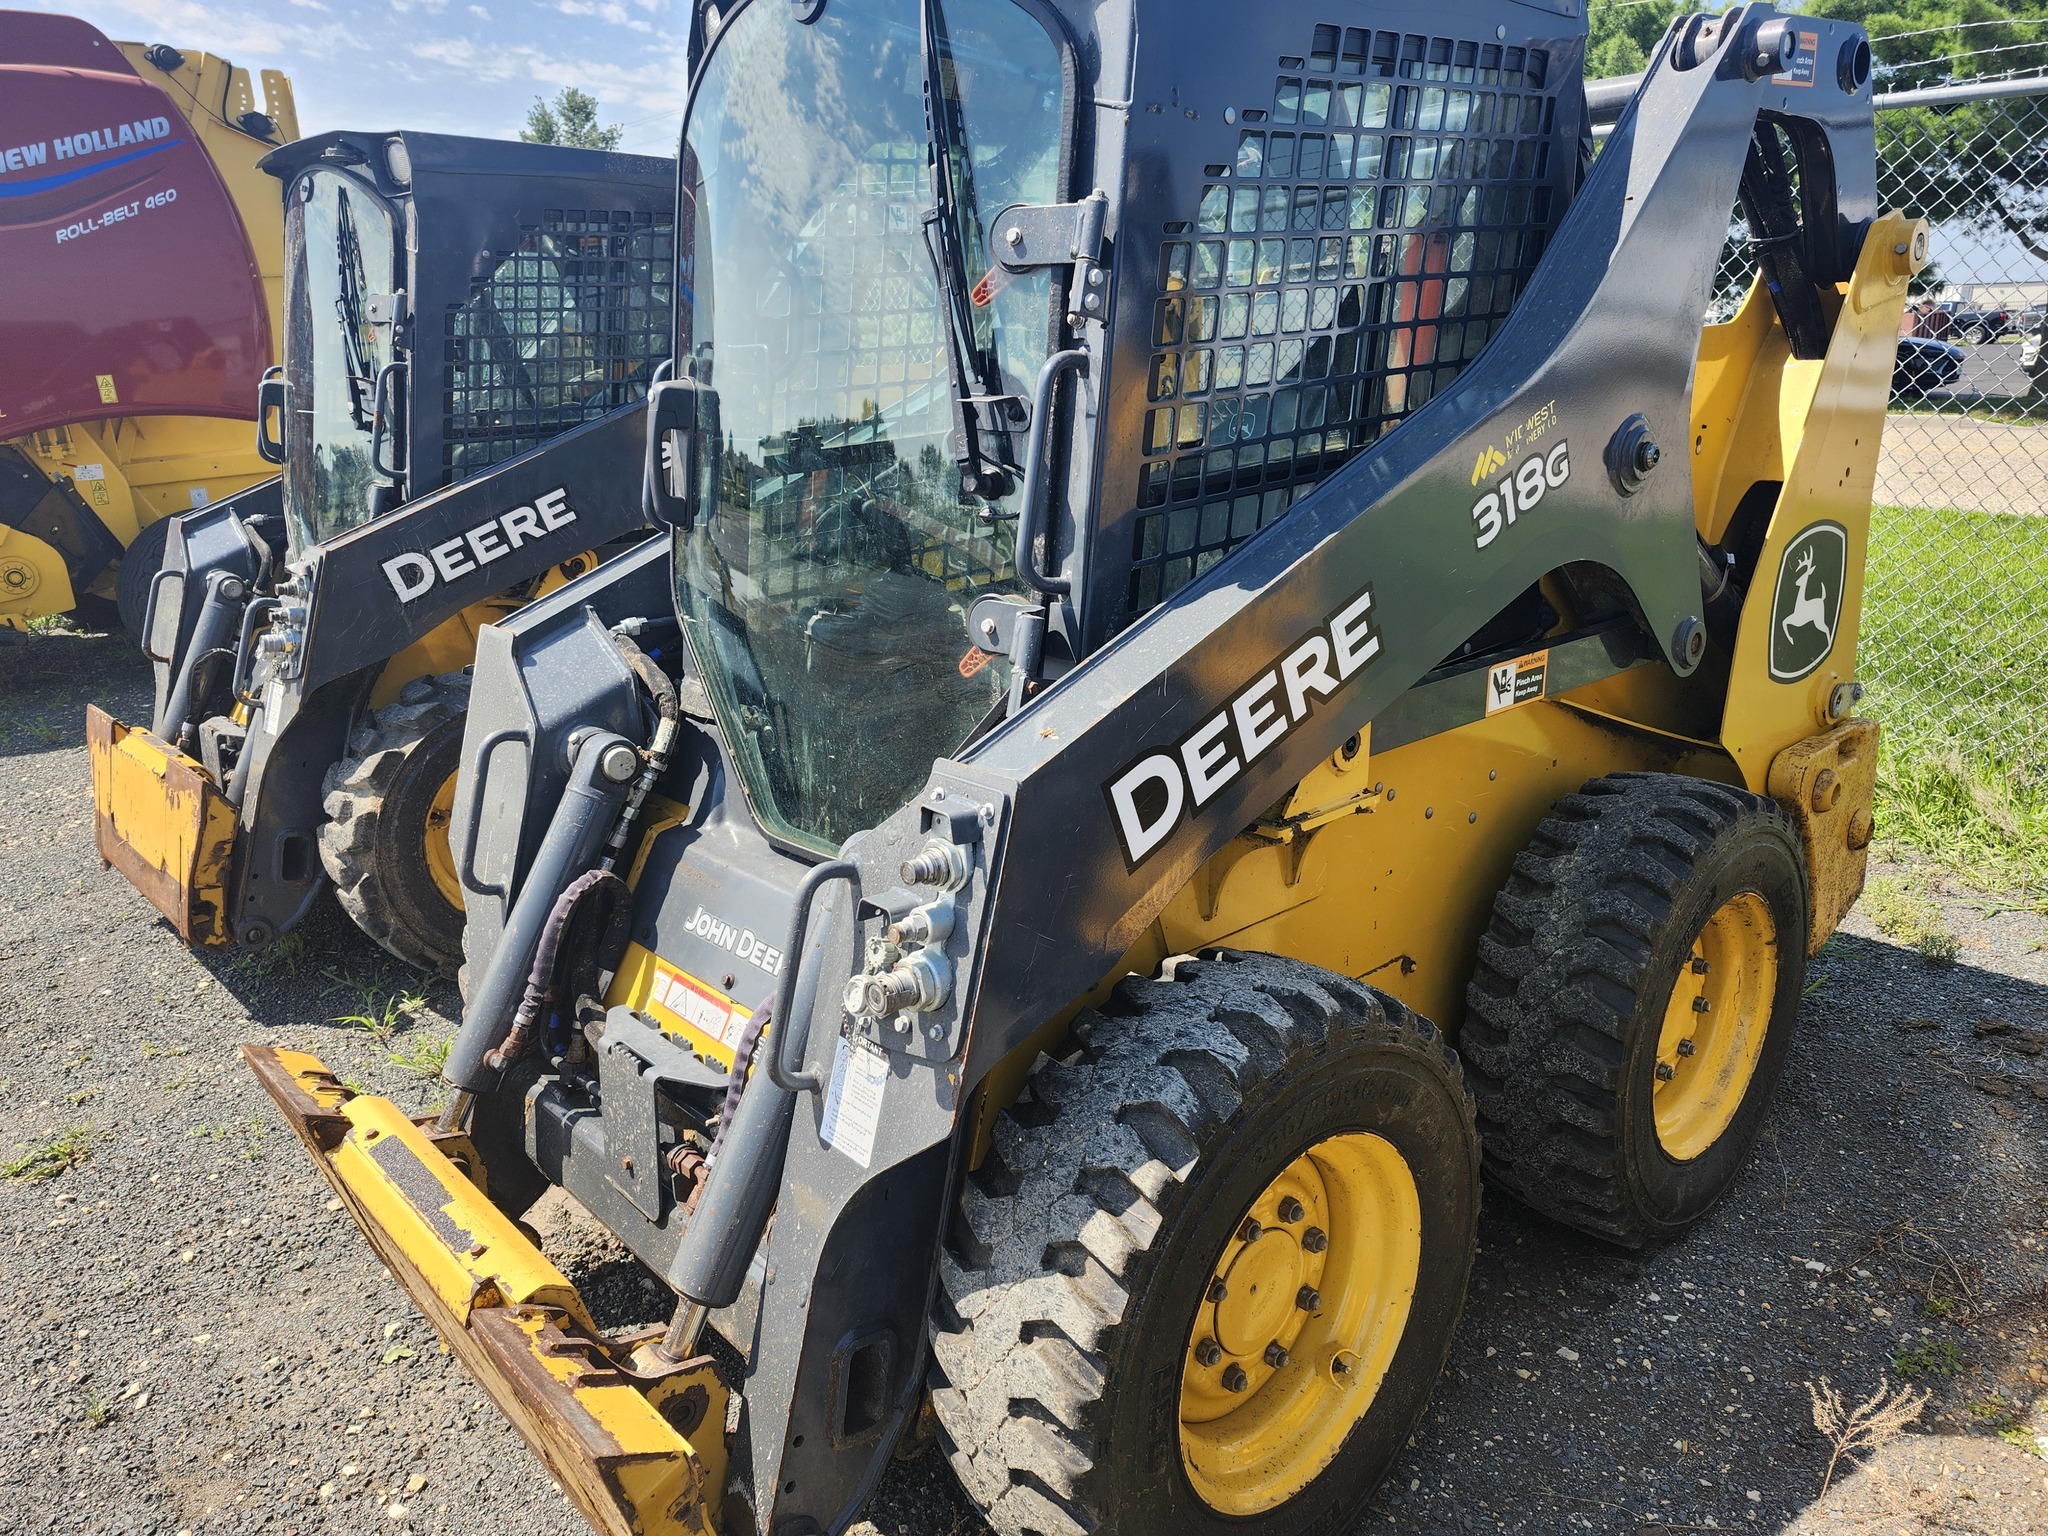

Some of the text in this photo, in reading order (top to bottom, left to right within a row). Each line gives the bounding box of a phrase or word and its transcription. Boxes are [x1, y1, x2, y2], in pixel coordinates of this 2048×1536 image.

[53, 116, 170, 161] HOLLAND
[56, 188, 177, 244] ROLL-BELT 460
[1472, 442, 1570, 549] 318G
[381, 487, 577, 604] DEERE
[1515, 688, 1525, 697] Keep
[1516, 674, 1543, 687] Pinch Area
[1110, 590, 1380, 863] DEERE
[684, 905, 738, 952] JOHN
